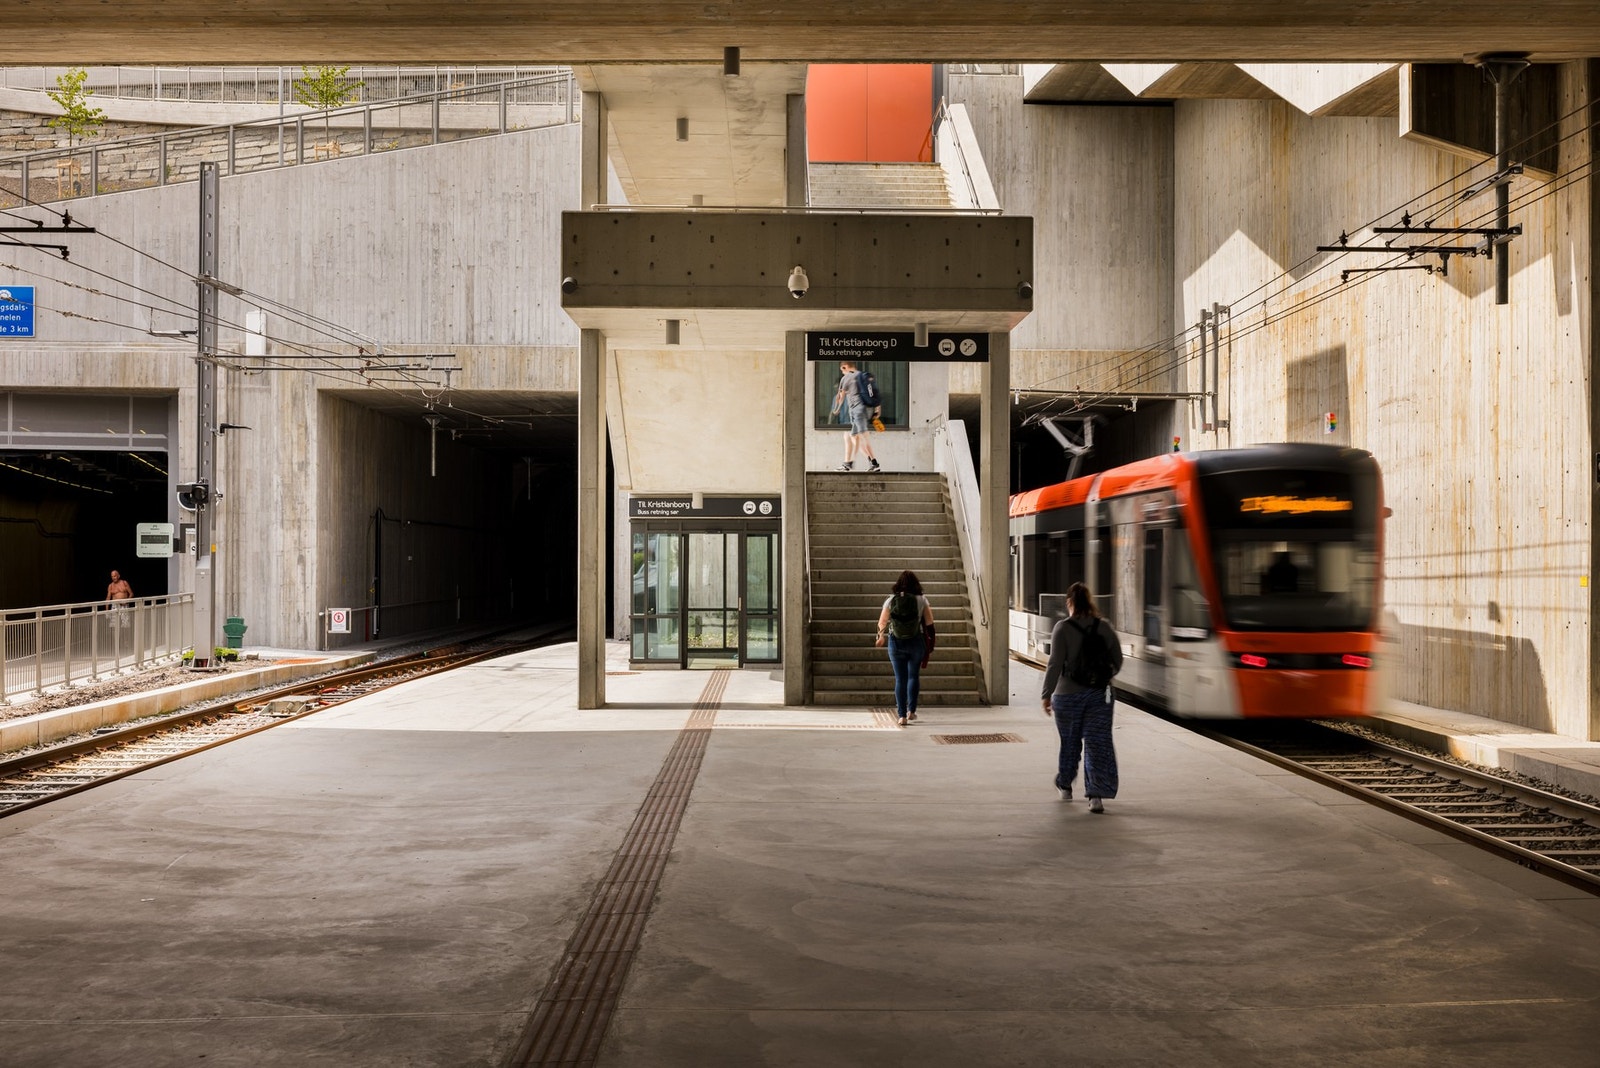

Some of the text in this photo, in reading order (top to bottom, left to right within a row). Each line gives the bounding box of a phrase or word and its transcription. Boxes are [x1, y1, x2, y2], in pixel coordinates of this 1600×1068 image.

[10, 325, 15, 333] 3
[17, 325, 29, 333] km
[819, 337, 897, 349] Til Kristianborg D
[819, 348, 835, 356] Buss
[836, 349, 862, 358] retning
[648, 501, 690, 510] Kristianborg
